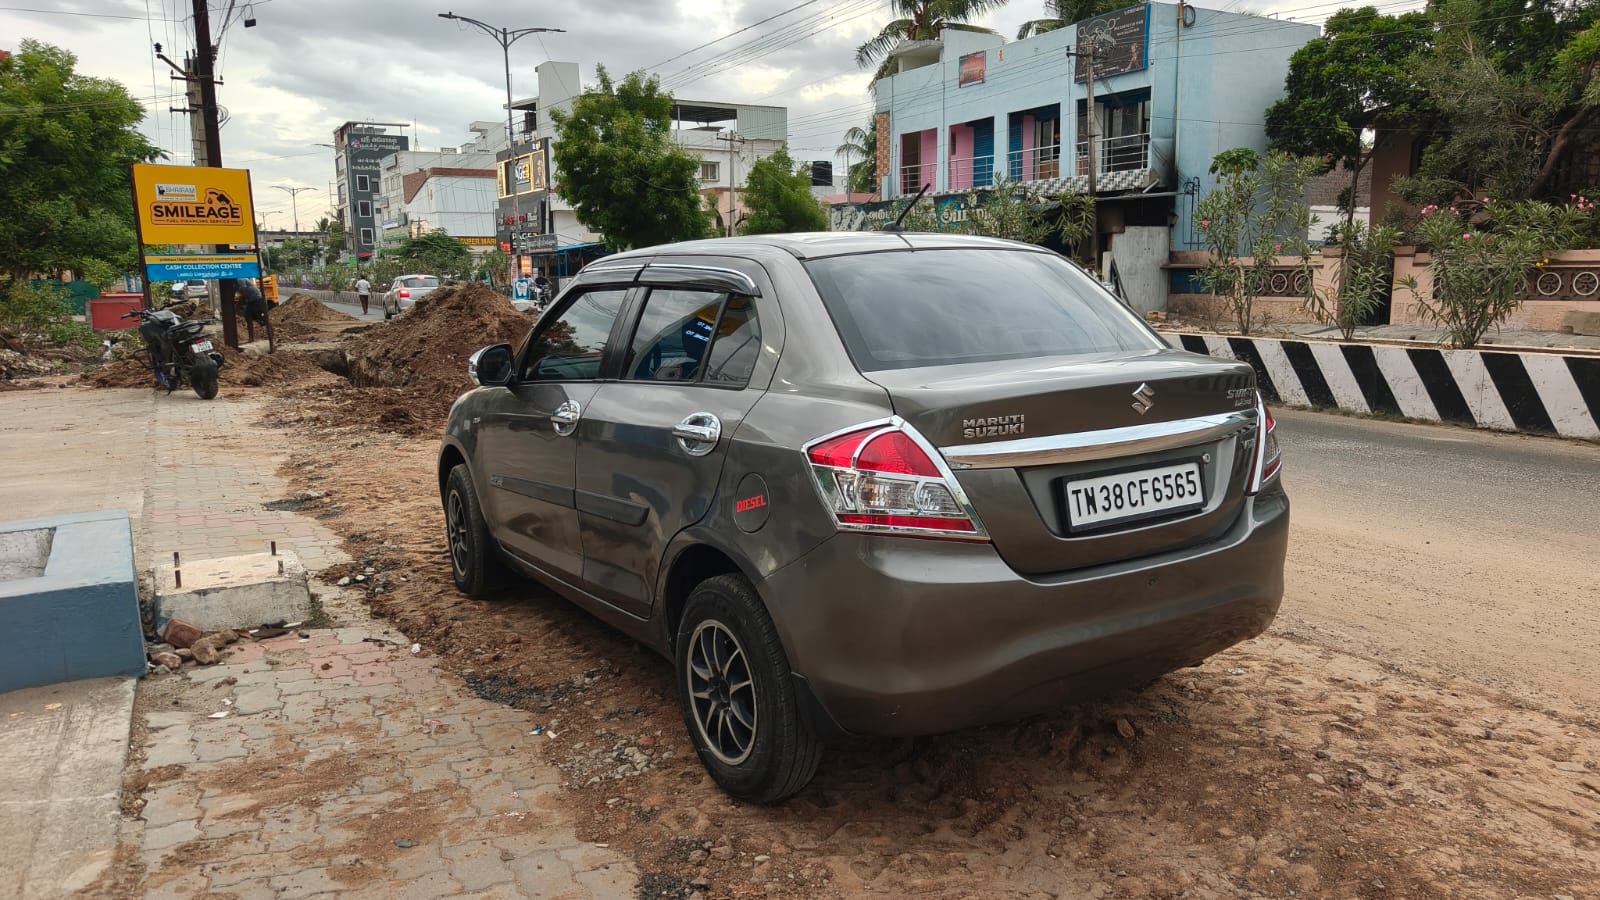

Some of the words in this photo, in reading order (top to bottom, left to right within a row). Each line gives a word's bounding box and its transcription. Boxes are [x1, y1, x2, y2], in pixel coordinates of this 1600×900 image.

[153, 205, 240, 218] SMILEAGE
[963, 414, 1025, 428] MARUTI
[963, 422, 1025, 439] SUZUKI
[1071, 470, 1197, 517] TN38CF6565
[736, 494, 767, 513] DIESEL
